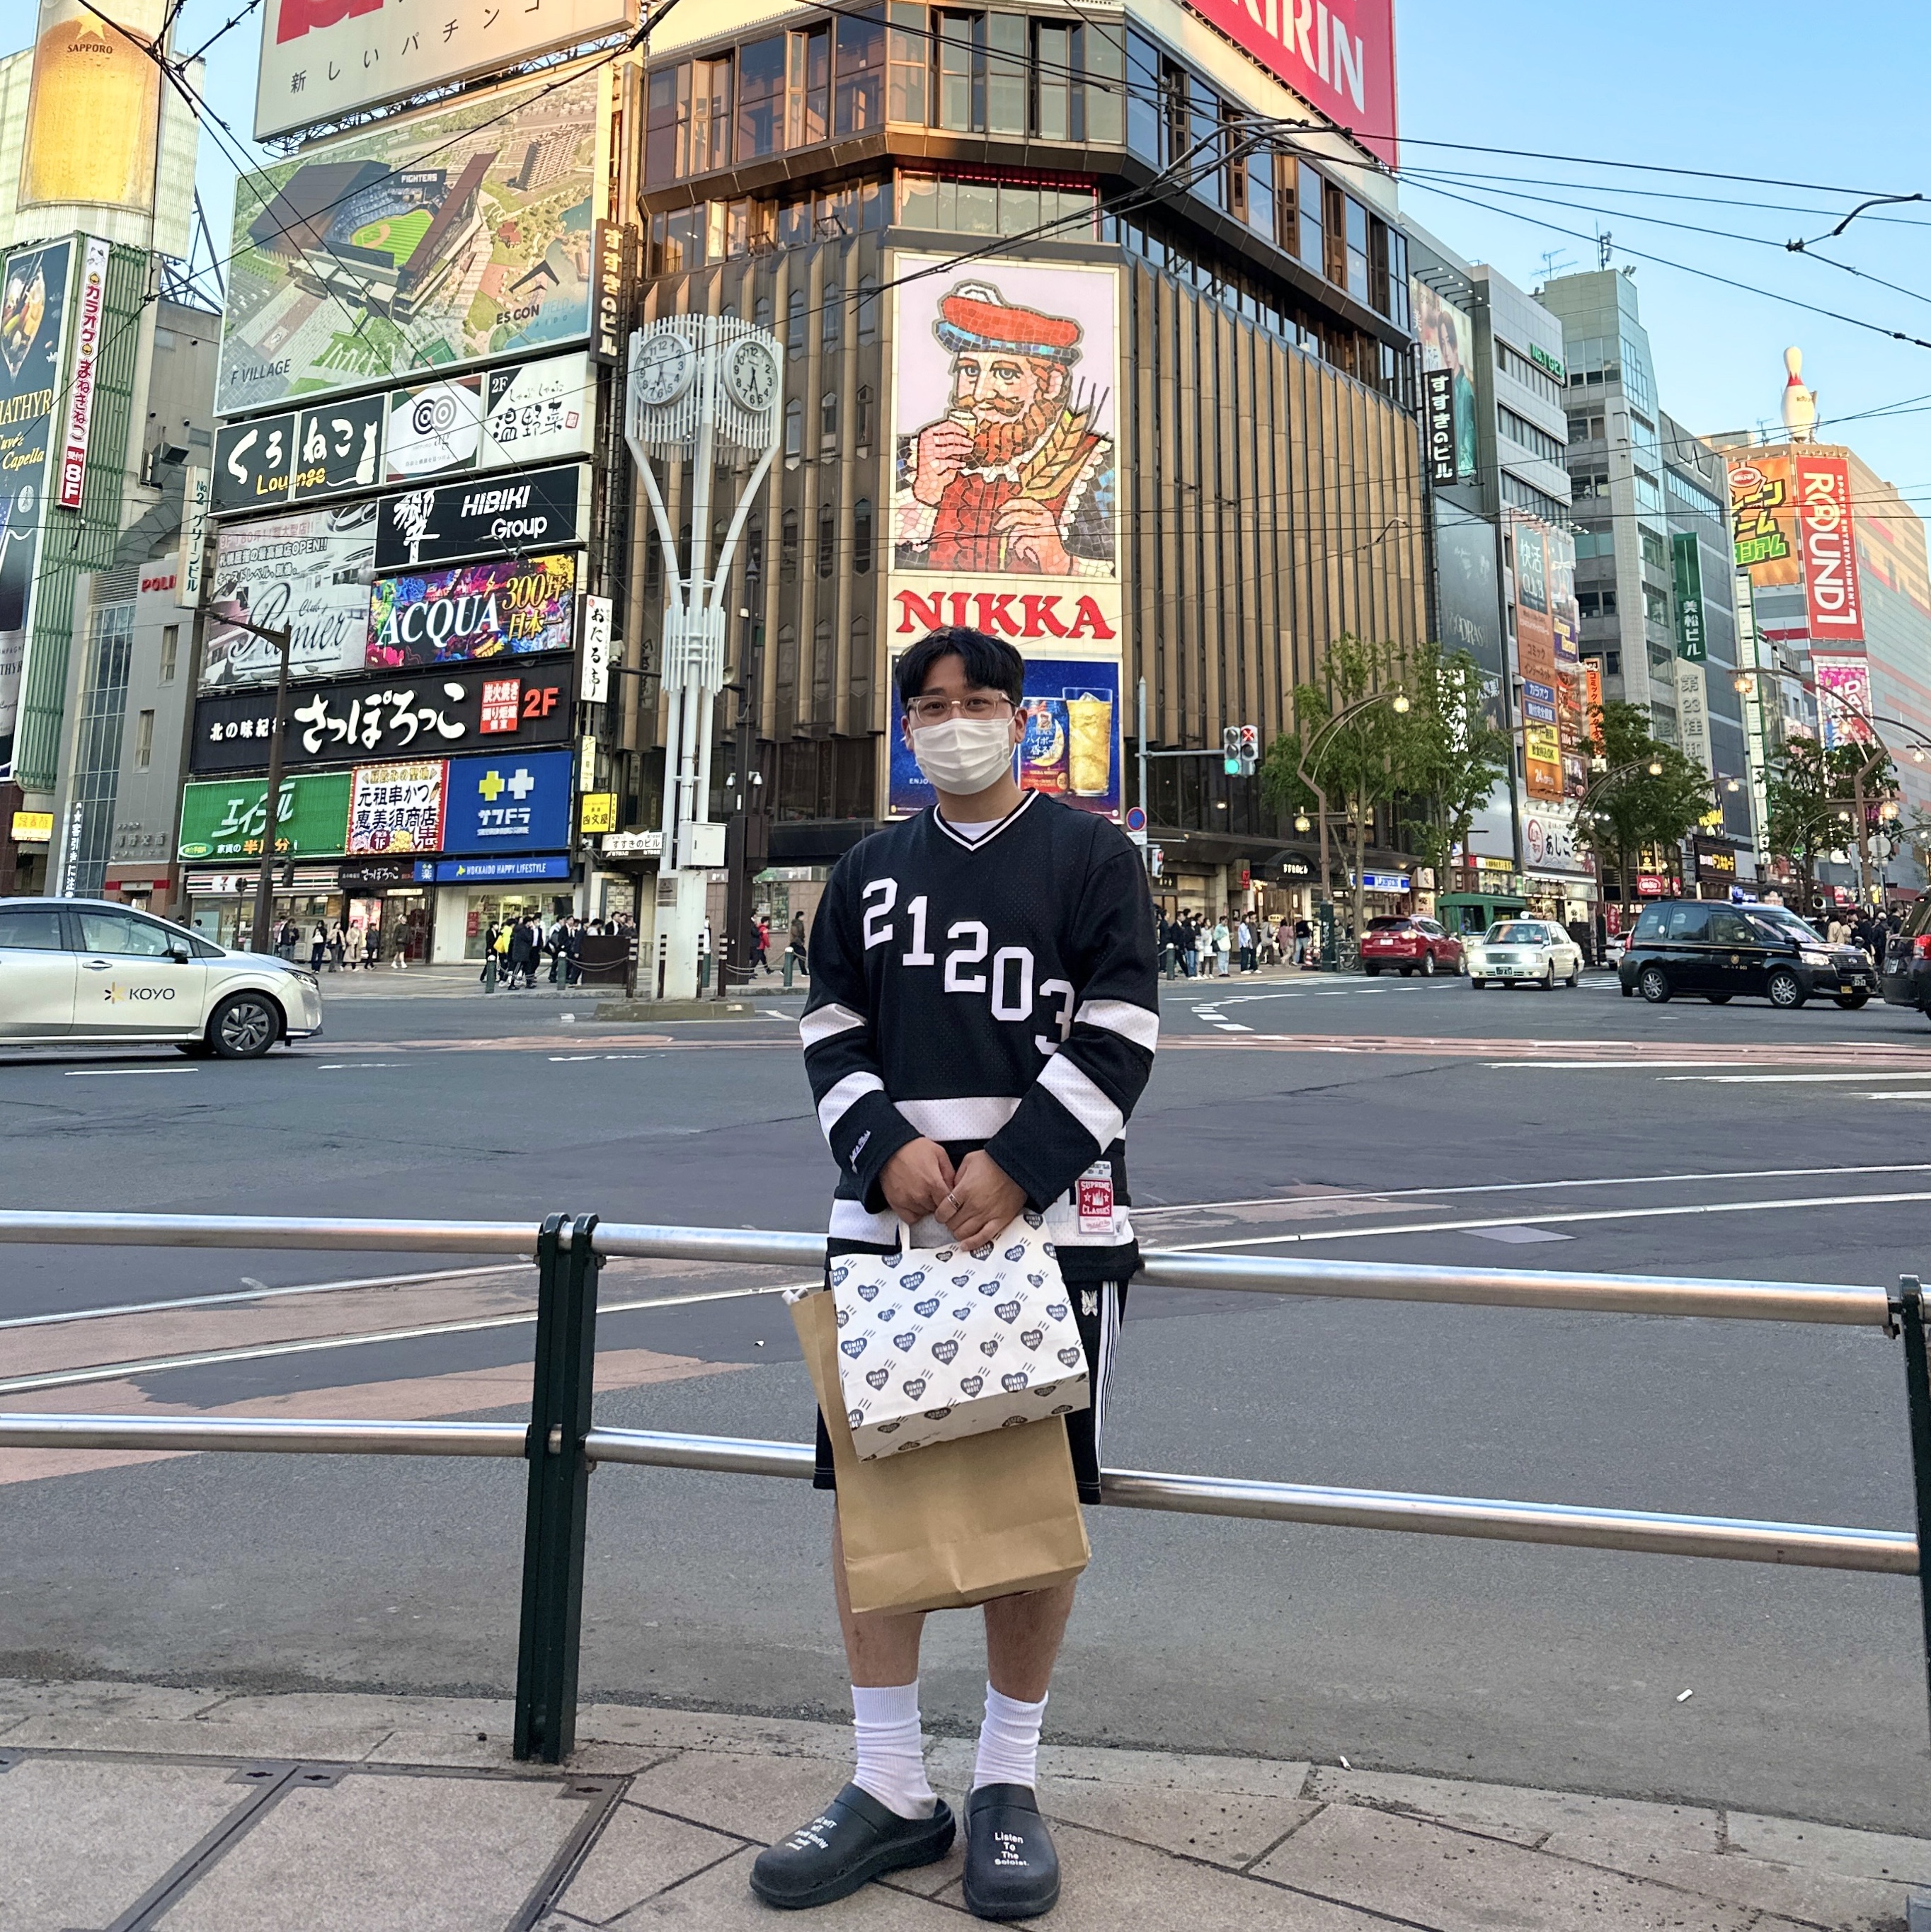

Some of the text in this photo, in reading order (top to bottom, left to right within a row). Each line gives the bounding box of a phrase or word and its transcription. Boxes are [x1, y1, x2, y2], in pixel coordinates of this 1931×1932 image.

[67, 44, 113, 54] SAPPORO
[401, 173, 437, 183] FIGHTERS
[599, 227, 623, 357] すすきのビル
[81, 284, 101, 343] カラオケ
[658, 340, 667, 350] 12
[650, 346, 657, 355] 11
[750, 347, 758, 356] 12
[677, 362, 684, 371] 3
[734, 365, 740, 374] 9
[765, 364, 771, 374] 2
[231, 359, 291, 385] F VILLAGE
[640, 369, 646, 379] 9
[674, 374, 680, 382] 4
[736, 378, 741, 387] 8
[767, 377, 773, 386] 3
[491, 376, 508, 393] 2F
[642, 380, 648, 389] 8
[667, 383, 672, 393] 5
[650, 387, 655, 396] 7
[658, 389, 663, 398] 6
[743, 389, 747, 398] 7
[764, 388, 769, 397] 4
[70, 358, 93, 442] まねきねこ
[750, 394, 755, 404] 6
[1431, 375, 1452, 479] すすきのビル
[227, 416, 354, 485] くろねこ
[2, 447, 45, 471] Capella
[256, 467, 326, 495] Lounge
[461, 485, 531, 518] HIBIKI
[491, 516, 548, 539] Group
[1520, 539, 1542, 573] 快活
[1840, 518, 1855, 607] ENTERTAINMENT
[1522, 573, 1545, 599] CLUB
[894, 590, 1116, 639] NIKKA
[375, 593, 500, 648] ACQUA
[508, 610, 563, 641] 日本一
[1683, 601, 1701, 656] 美松ビル
[1530, 684, 1549, 699] カラオケ
[522, 687, 558, 718] 2F
[294, 682, 466, 754] さっぽろっこ
[357, 785, 430, 807] 元祖串かつ
[355, 806, 437, 830] 恵美須商店
[613, 839, 660, 849] すすきのビル
[466, 863, 546, 875] HOKKAIDO HAPPY LIFESTYLE
[130, 988, 175, 1000] KOYO
[1081, 1181, 1111, 1192] SUPREME
[903, 1274, 922, 1284] HUMAN
[917, 1301, 936, 1311] HUMAN
[998, 1304, 1017, 1313] HUMAN
[896, 1335, 913, 1343] HUMAN
[844, 1340, 864, 1350] HUMAN
[935, 1343, 955, 1354] HUMAN
[869, 1372, 886, 1381] HUMAN
[1004, 1376, 1024, 1384] HUMAN
[906, 1382, 923, 1391] HUMAN
[995, 1831, 1024, 1844] Listen
[1003, 1841, 1016, 1852] To
[1001, 1851, 1019, 1860] The
